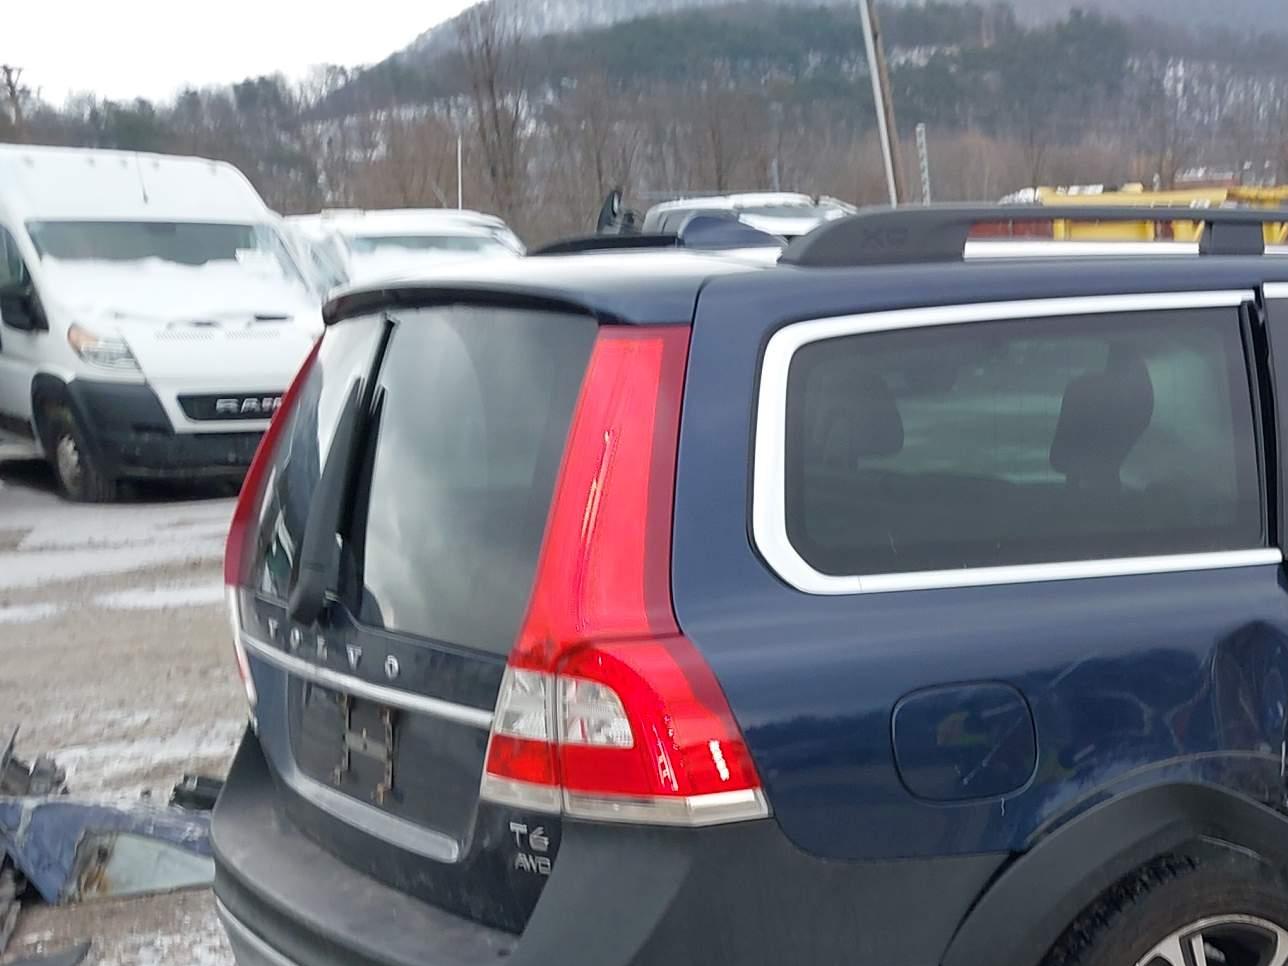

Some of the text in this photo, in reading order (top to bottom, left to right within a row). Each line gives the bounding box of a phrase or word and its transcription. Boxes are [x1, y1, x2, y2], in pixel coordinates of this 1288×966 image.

[267, 617, 400, 681] VOLVO
[509, 821, 550, 851] T6
[514, 852, 552, 875] AWD
